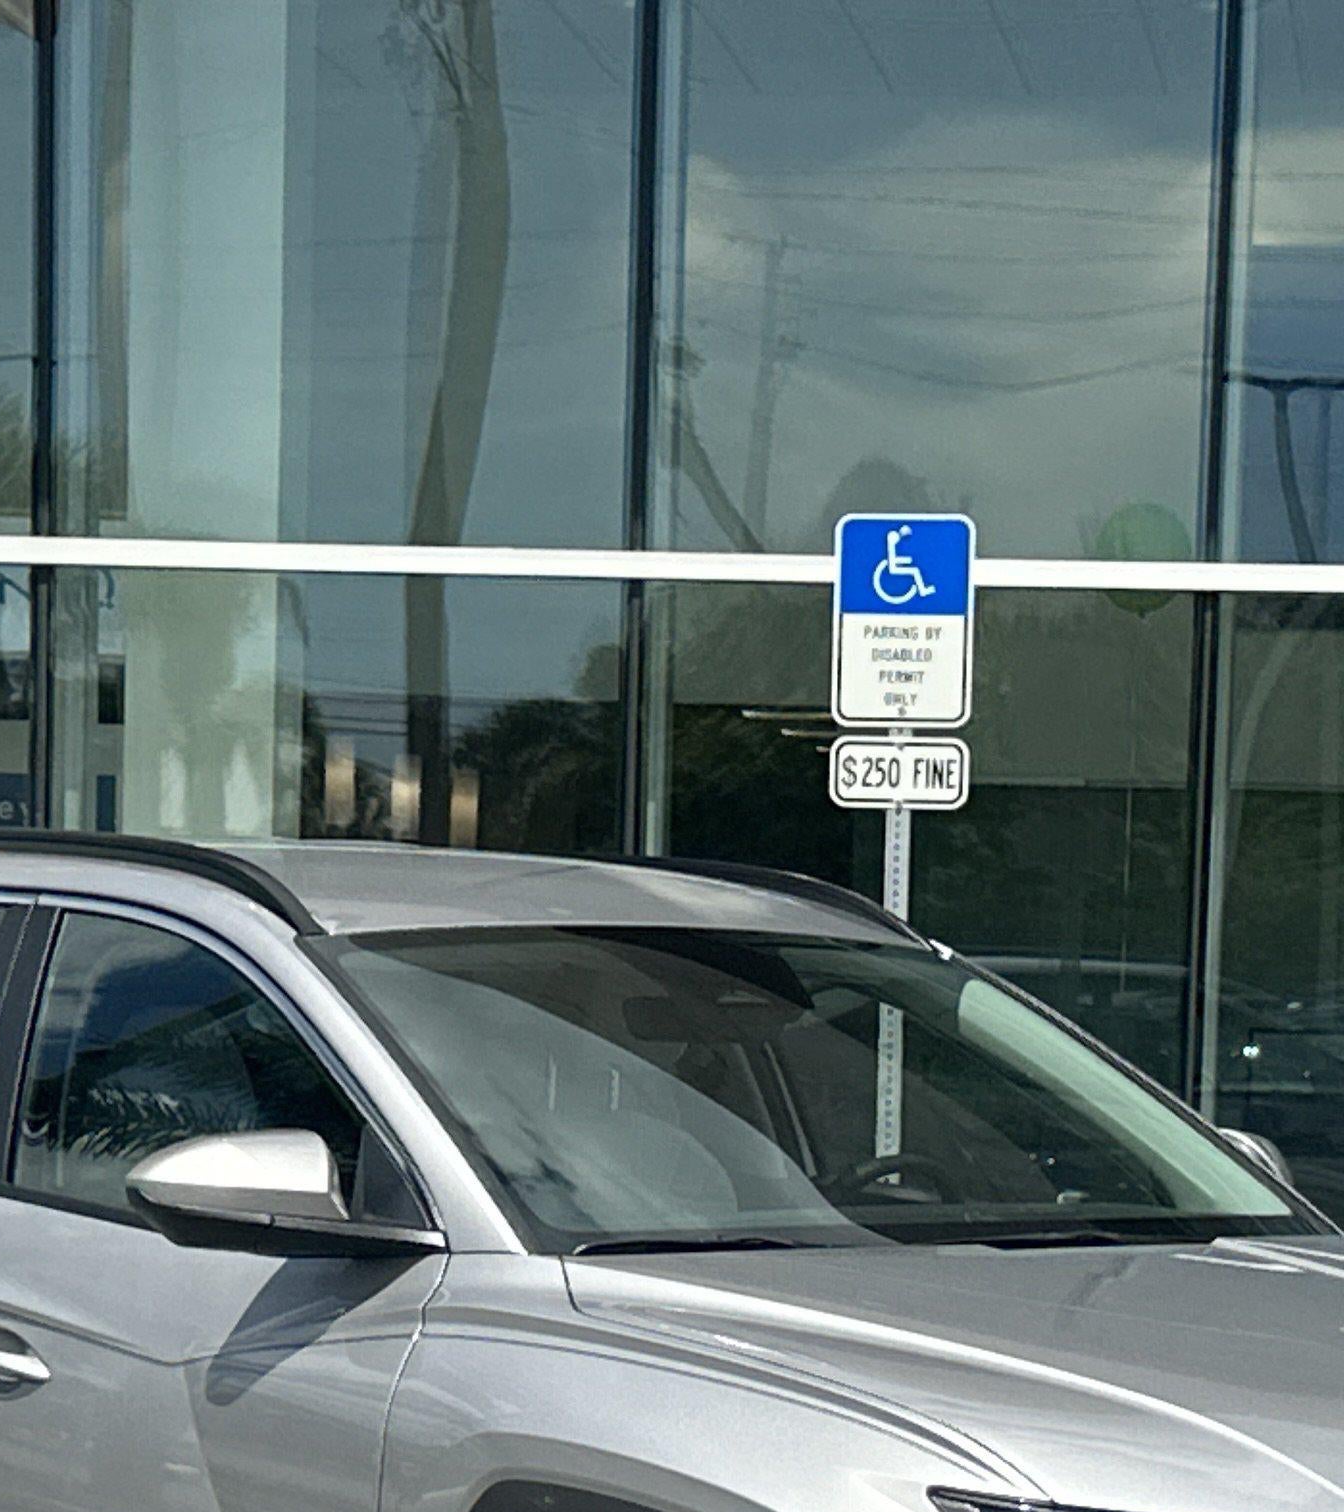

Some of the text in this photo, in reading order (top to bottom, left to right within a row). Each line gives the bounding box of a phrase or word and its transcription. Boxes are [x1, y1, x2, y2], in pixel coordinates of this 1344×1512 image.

[863, 624, 942, 641] PARKING BY
[871, 647, 933, 662] DISABLED
[879, 670, 925, 684] PERMIT
[840, 754, 957, 790] $250 FINE
